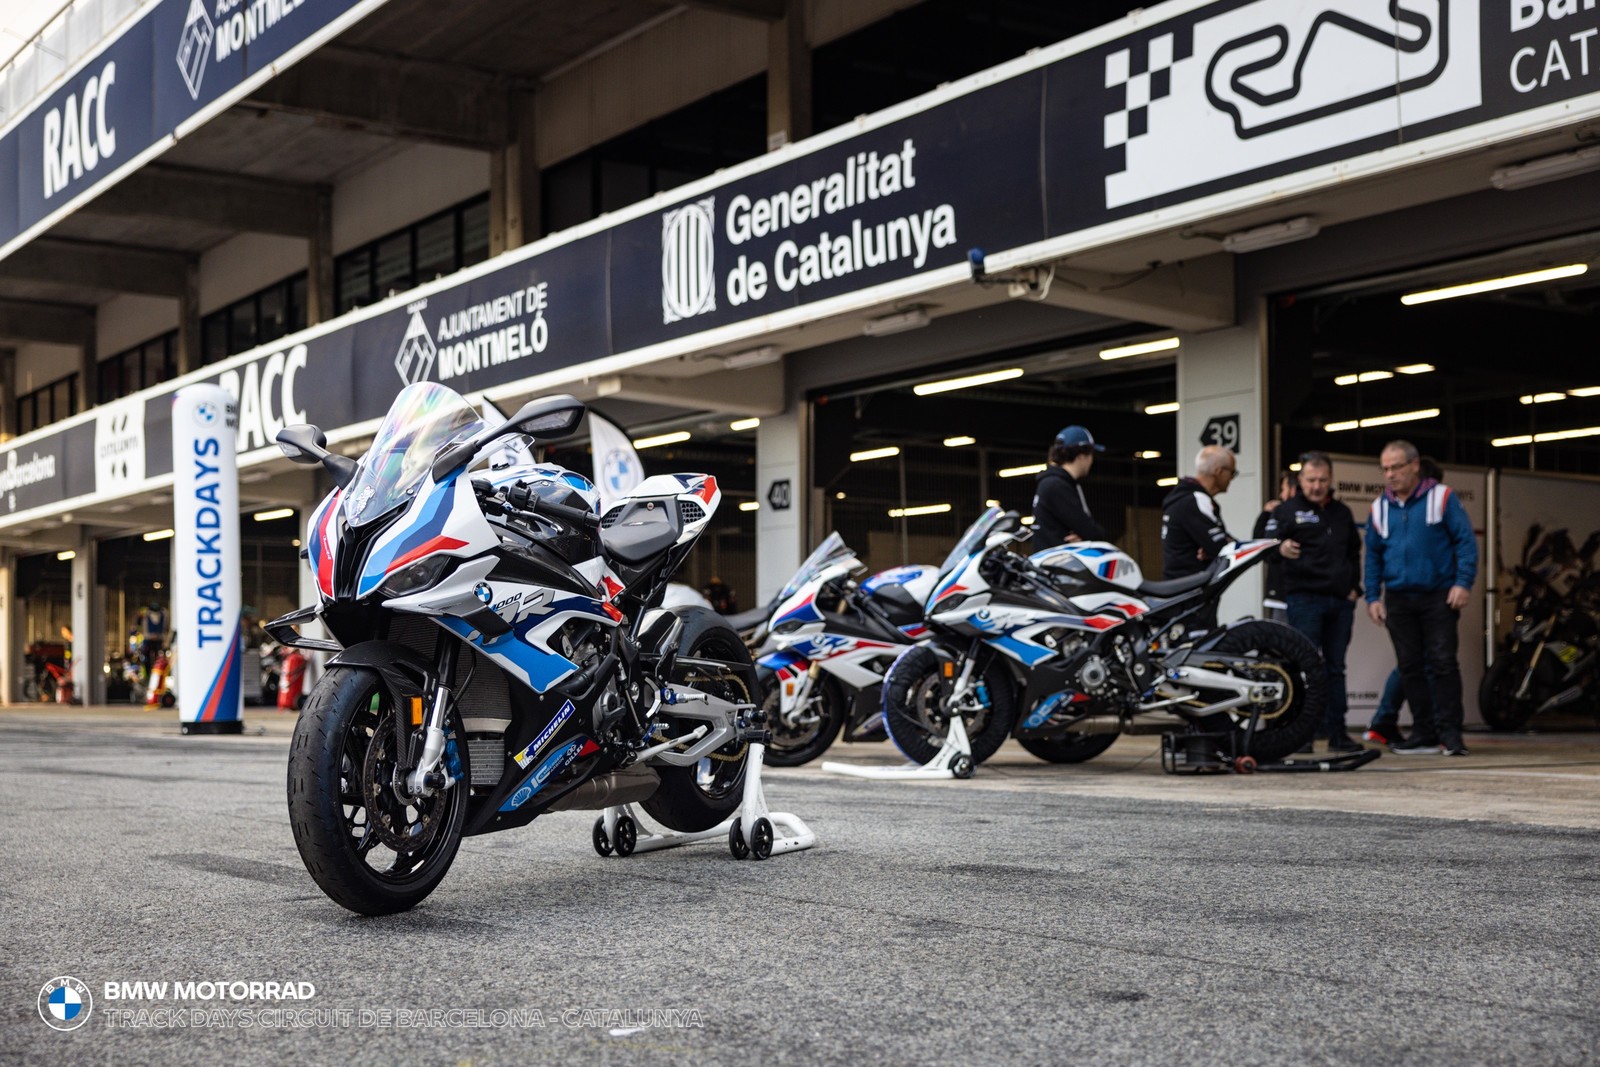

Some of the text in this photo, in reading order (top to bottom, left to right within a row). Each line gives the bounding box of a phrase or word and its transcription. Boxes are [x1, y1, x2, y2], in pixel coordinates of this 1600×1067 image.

[1509, 27, 1600, 93] CAT
[43, 60, 116, 200] RACC
[726, 138, 916, 245] Generalitat
[726, 204, 957, 306] de Catalunya
[437, 282, 548, 342] AJUNTAMENT DE
[438, 310, 548, 380] MONTMELÓ
[1209, 420, 1238, 449] 39
[770, 483, 789, 507] 40
[194, 438, 222, 648] TRACKDAYS
[532, 704, 571, 752] MICHELIN
